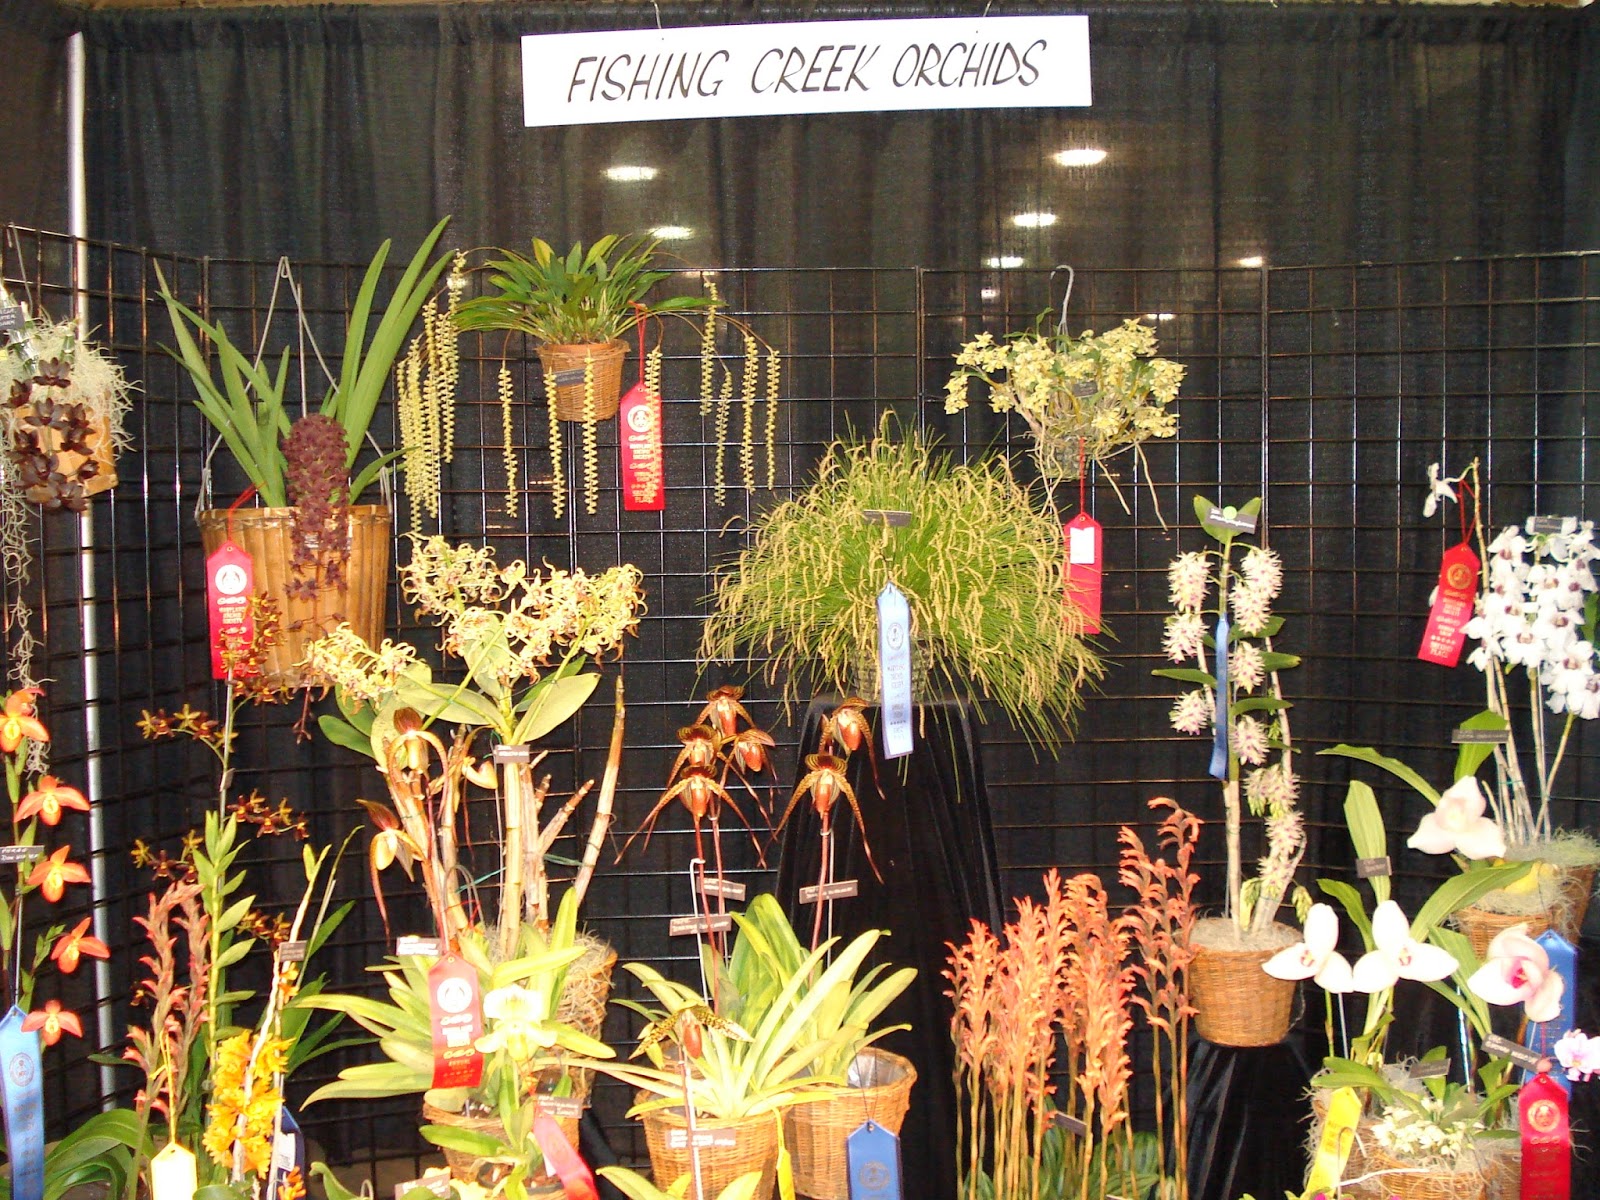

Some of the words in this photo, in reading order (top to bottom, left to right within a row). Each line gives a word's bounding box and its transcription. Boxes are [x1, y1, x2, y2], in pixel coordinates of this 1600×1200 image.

[567, 49, 730, 103] FISHING
[751, 44, 881, 94] CREEK
[892, 39, 1048, 88] ORCHIDS
